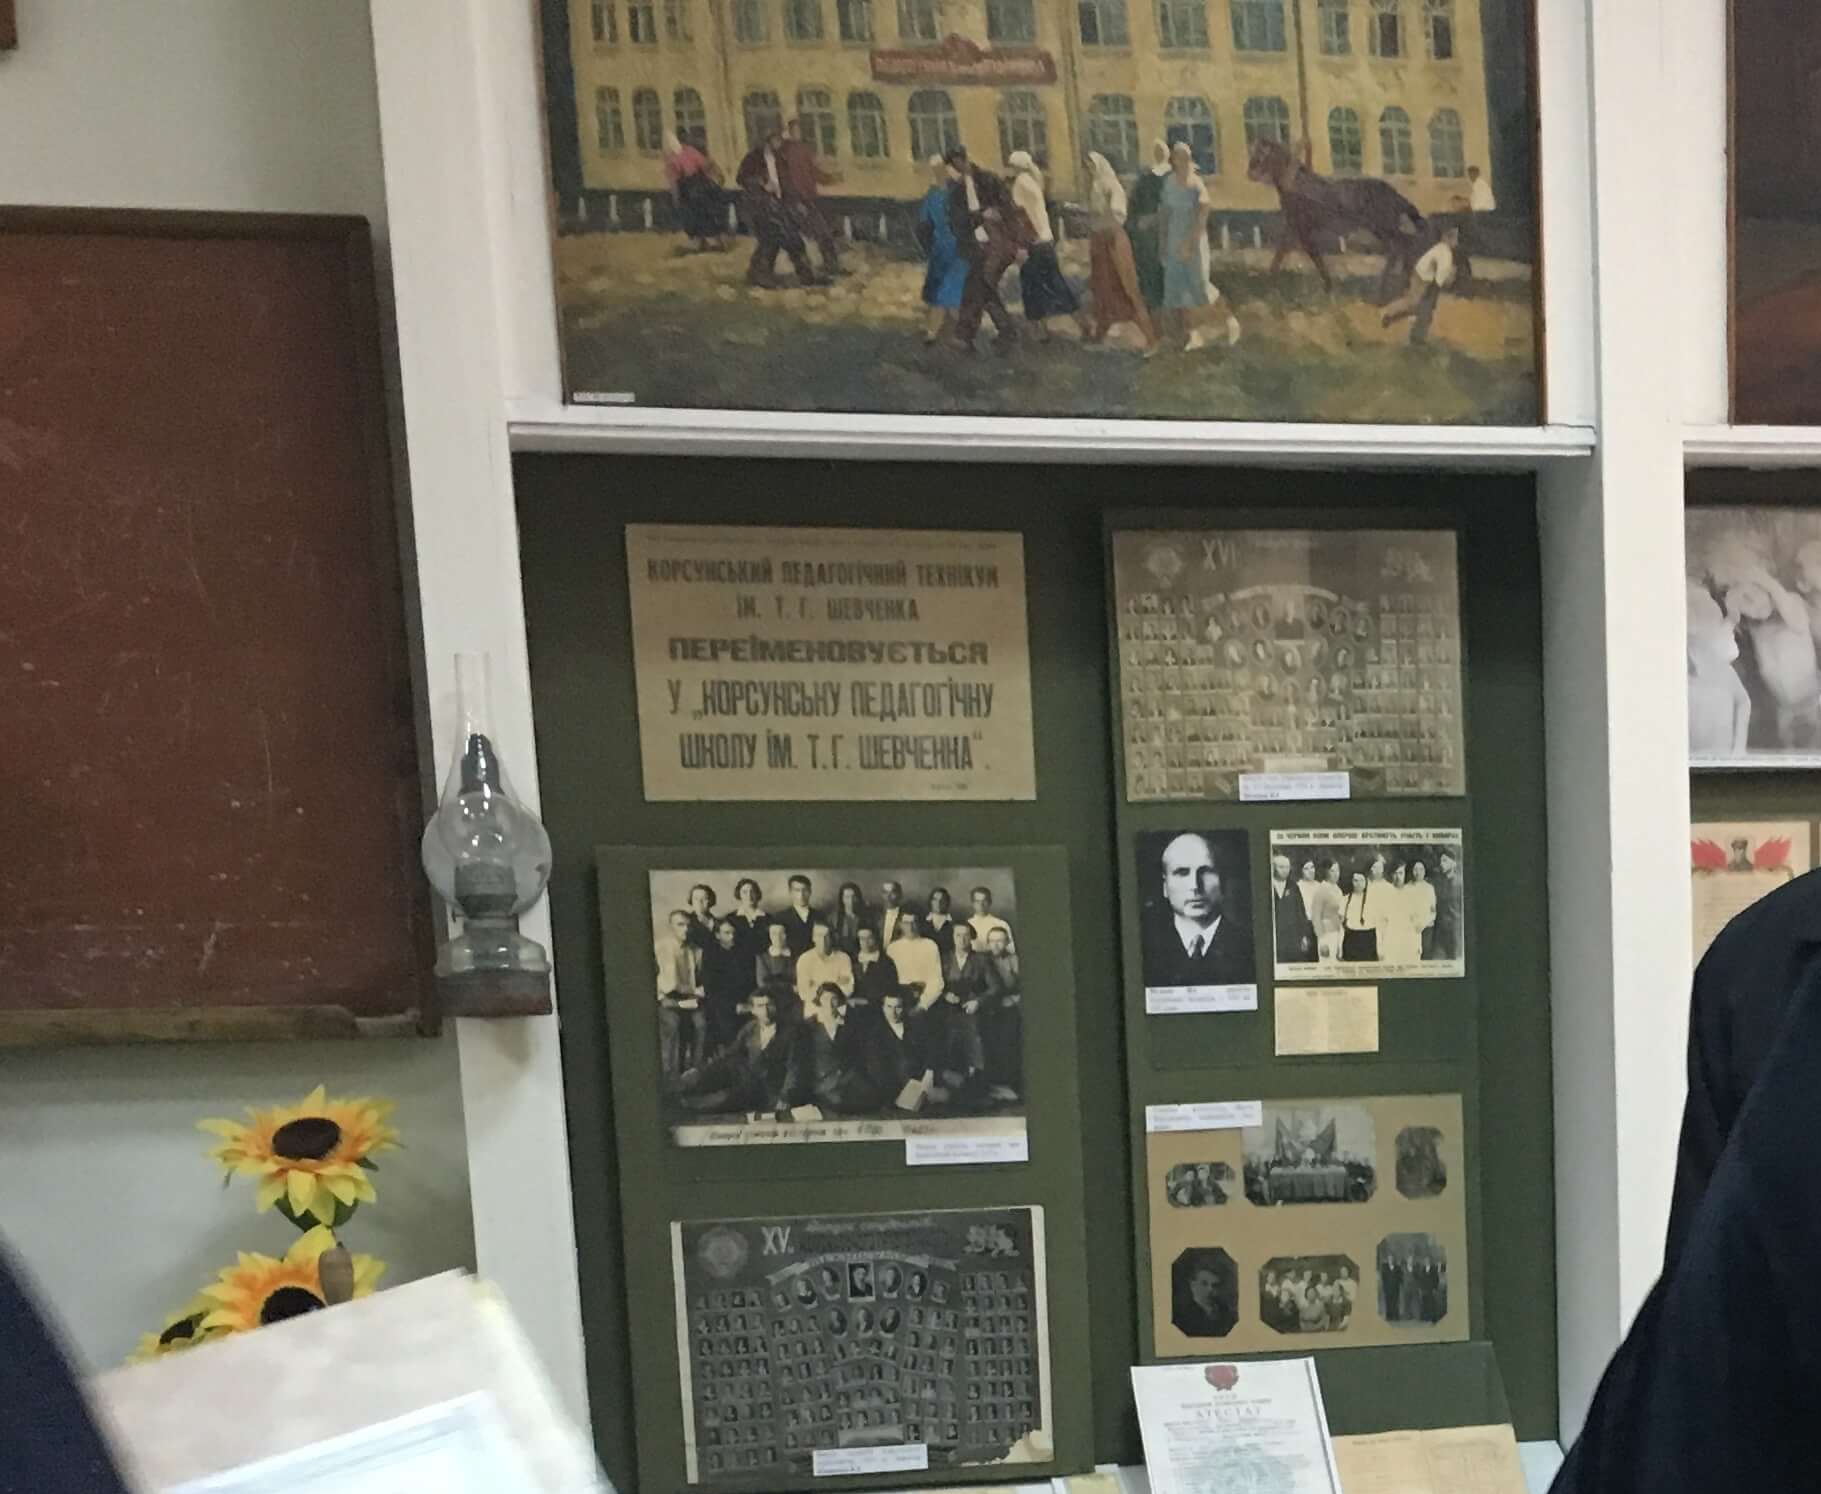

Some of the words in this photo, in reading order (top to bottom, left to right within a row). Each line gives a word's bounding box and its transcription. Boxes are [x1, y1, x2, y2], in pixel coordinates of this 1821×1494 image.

[647, 556, 773, 584] КОРСУНСЬКИЙ
[781, 559, 906, 588] ПЕДАГОГІЧНИЙ
[915, 563, 1000, 588] ТЕХНІКУМ
[827, 597, 920, 622] ШЕВЧЕНКА
[667, 678, 681, 715] У
[851, 676, 994, 722] ПЕДАГОГІЧНУ
[679, 731, 757, 769] ШКОЛУ
